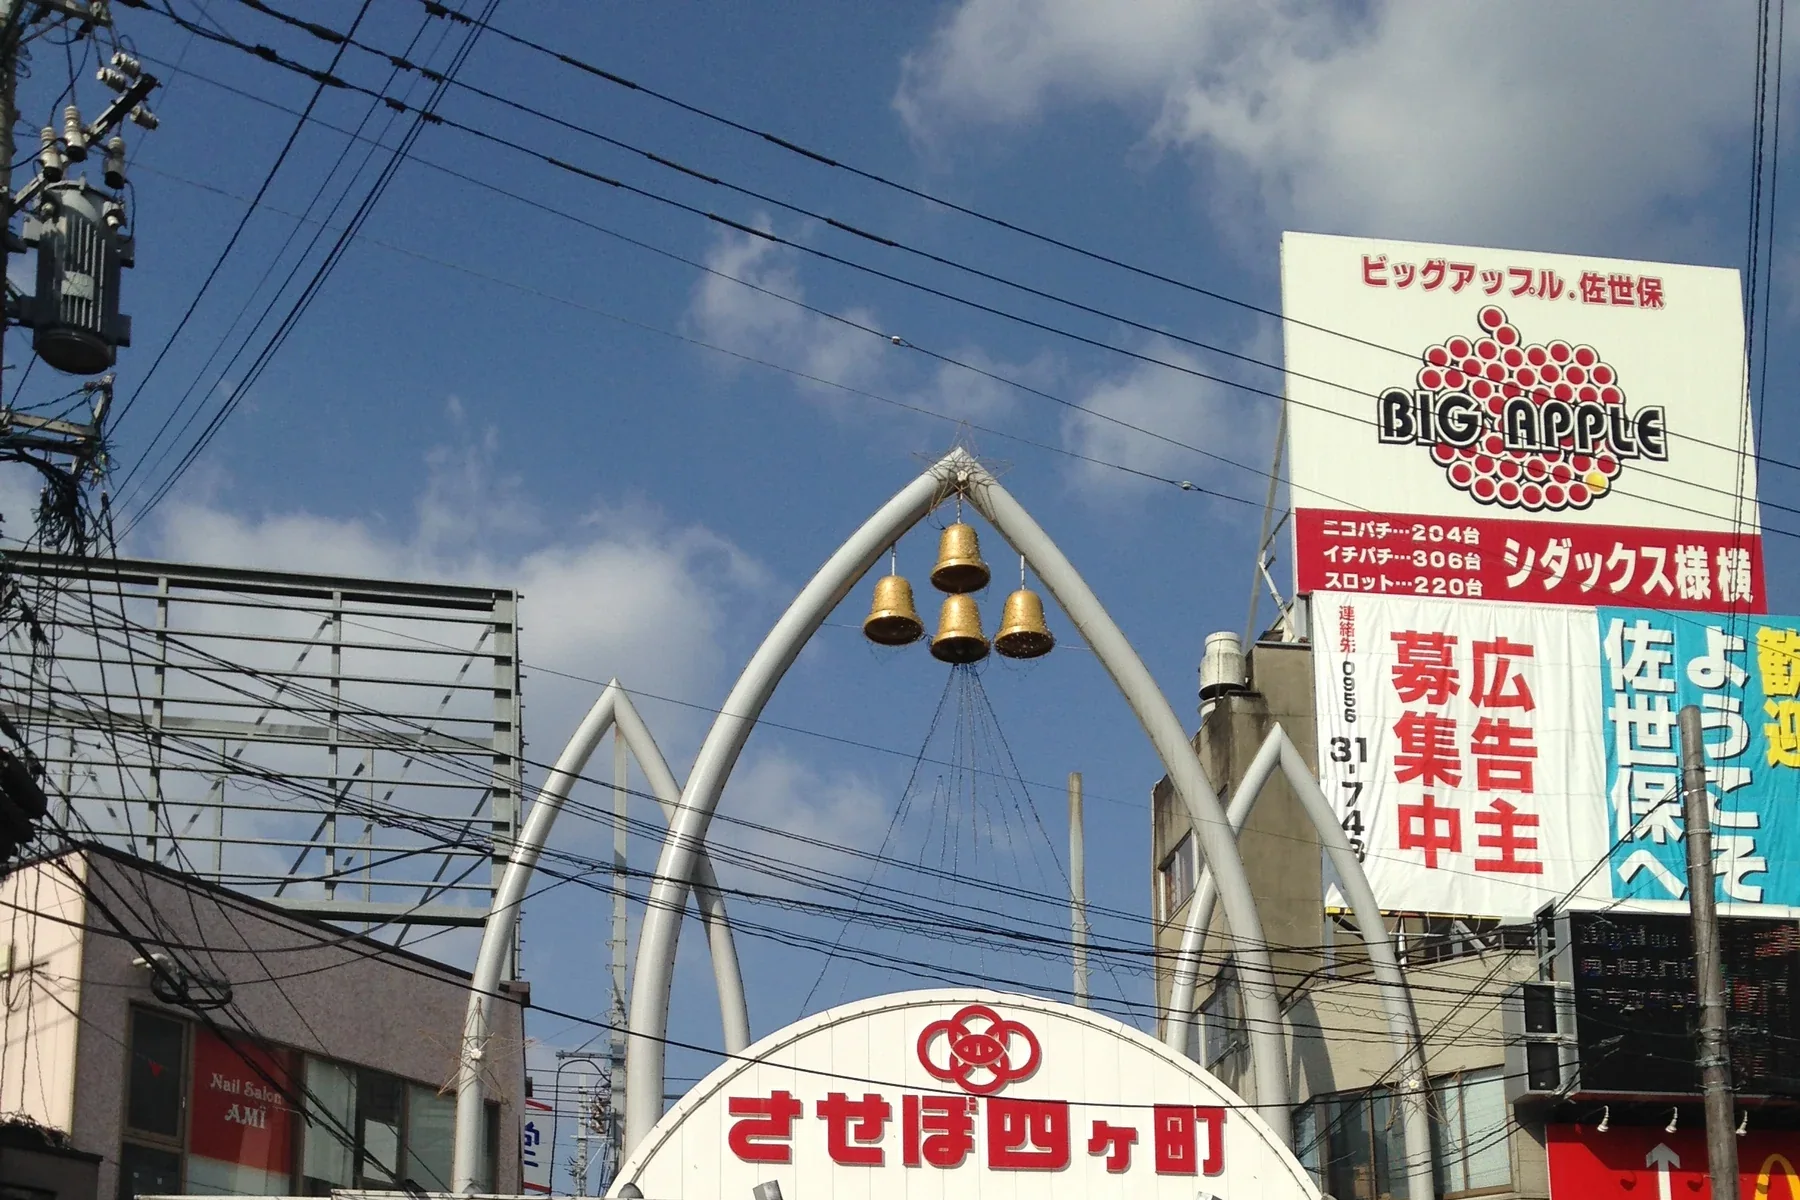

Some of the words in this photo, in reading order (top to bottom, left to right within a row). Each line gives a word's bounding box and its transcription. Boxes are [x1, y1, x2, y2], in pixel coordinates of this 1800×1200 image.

[1377, 386, 1484, 448] BIG
[1502, 394, 1669, 462] APPLE
[1338, 605, 1357, 654] 連絡先
[1390, 630, 1463, 870] 募集中
[1470, 637, 1544, 875] 広告主
[1604, 618, 1688, 900] 佐世保へ
[211, 1072, 241, 1094] Nail
[243, 1081, 283, 1106] Salon
[728, 1090, 1227, 1176] させぼ四ヶ町
